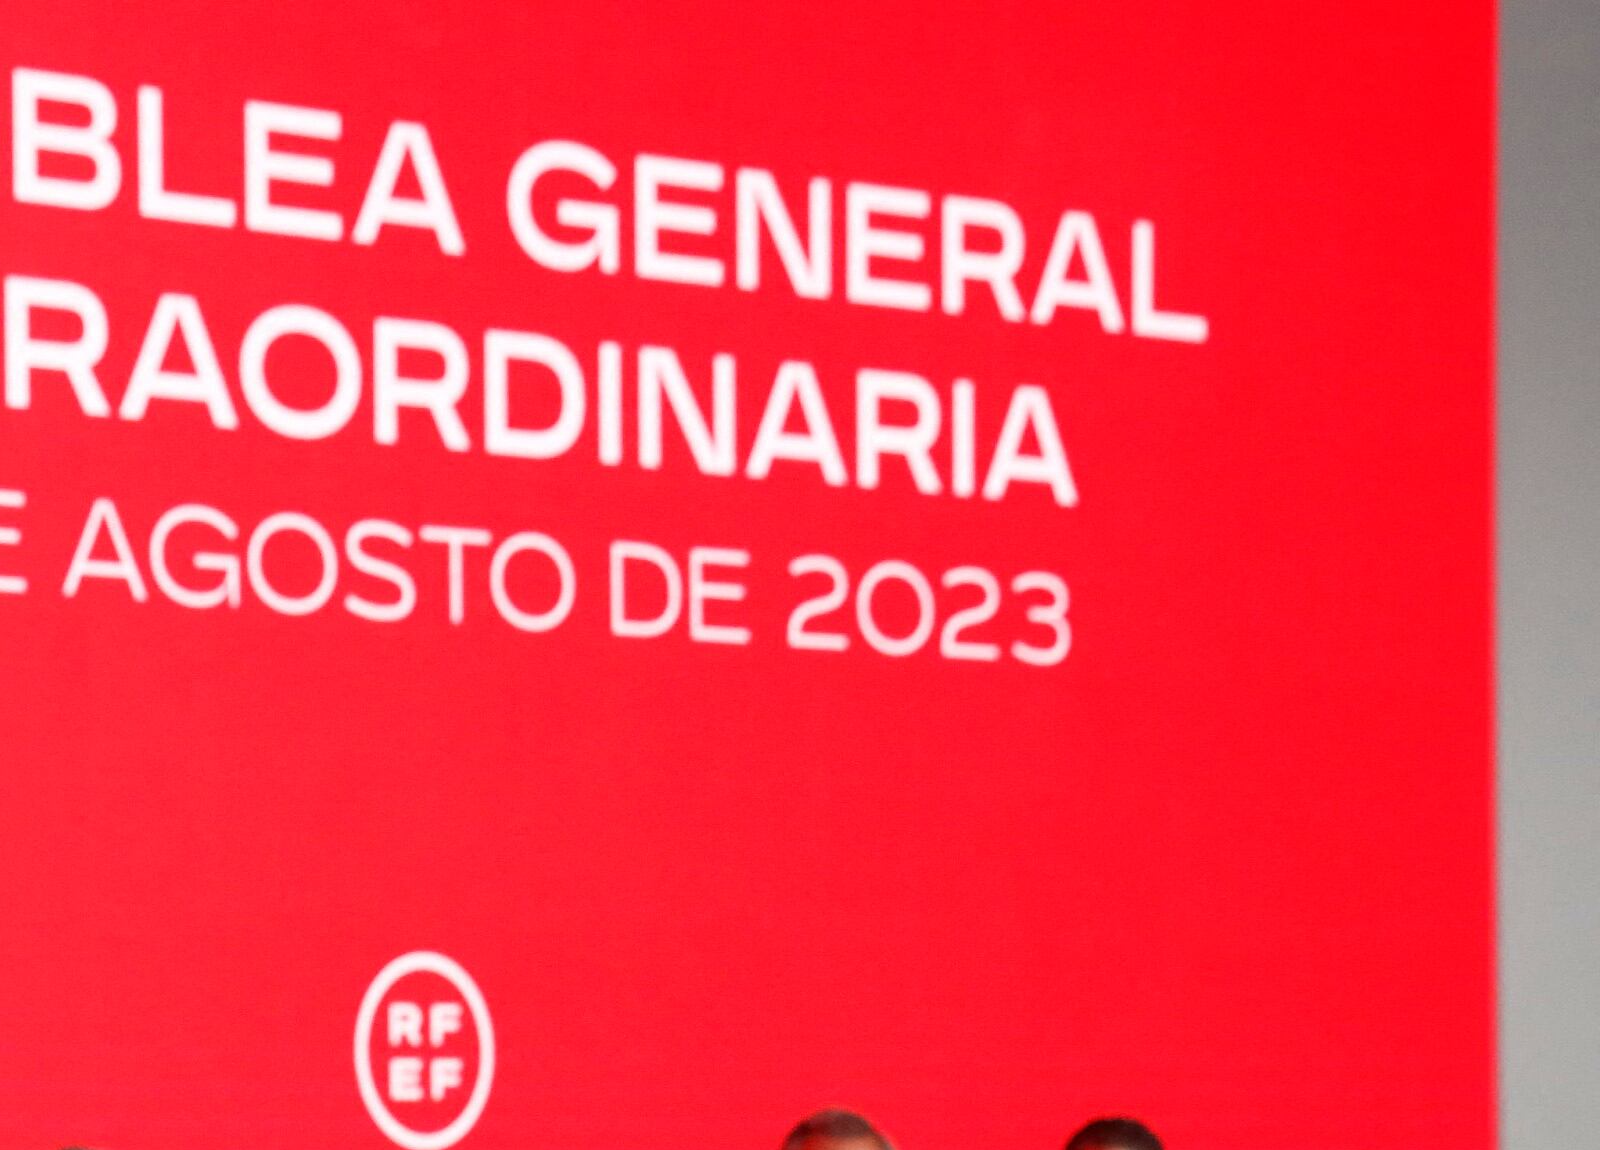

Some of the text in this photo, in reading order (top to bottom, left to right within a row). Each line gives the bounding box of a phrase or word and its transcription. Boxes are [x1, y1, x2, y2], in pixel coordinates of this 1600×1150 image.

[505, 139, 1209, 344] GENERAL
[61, 497, 577, 634] AGOSTO
[608, 539, 751, 646] DE
[786, 553, 1072, 667] 2023
